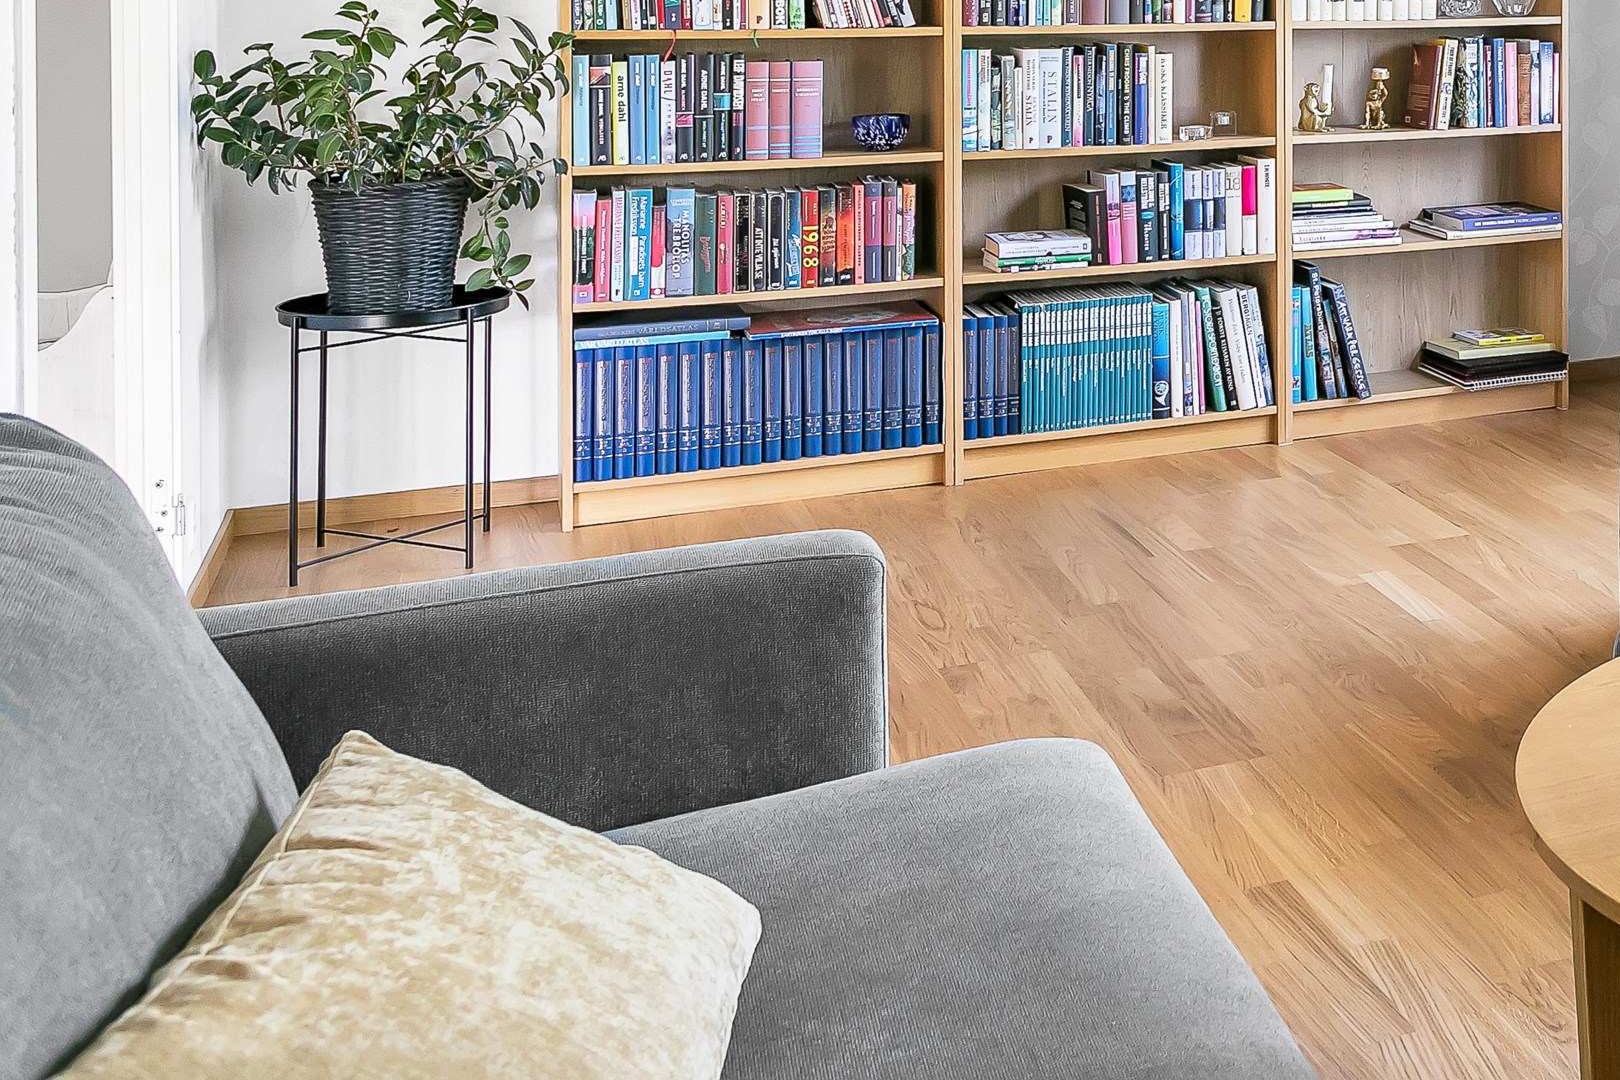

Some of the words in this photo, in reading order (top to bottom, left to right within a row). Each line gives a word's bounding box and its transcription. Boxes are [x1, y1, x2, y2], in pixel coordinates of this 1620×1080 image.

[774, 0, 785, 25] BOK
[618, 101, 626, 122] dahl
[1048, 71, 1057, 122] STALIN
[673, 218, 681, 234] TRE
[681, 210, 690, 264] MANOLITAS
[755, 227, 763, 238] ATT
[639, 236, 647, 269] Paradisets
[802, 225, 819, 268] 1968
[1203, 310, 1214, 332] STORA
[1241, 294, 1253, 336] BERGTAGEN
[1304, 325, 1313, 358] ATLAS
[1206, 333, 1222, 387] SPORTLEXIKON
[1351, 357, 1366, 390] GESSLE
